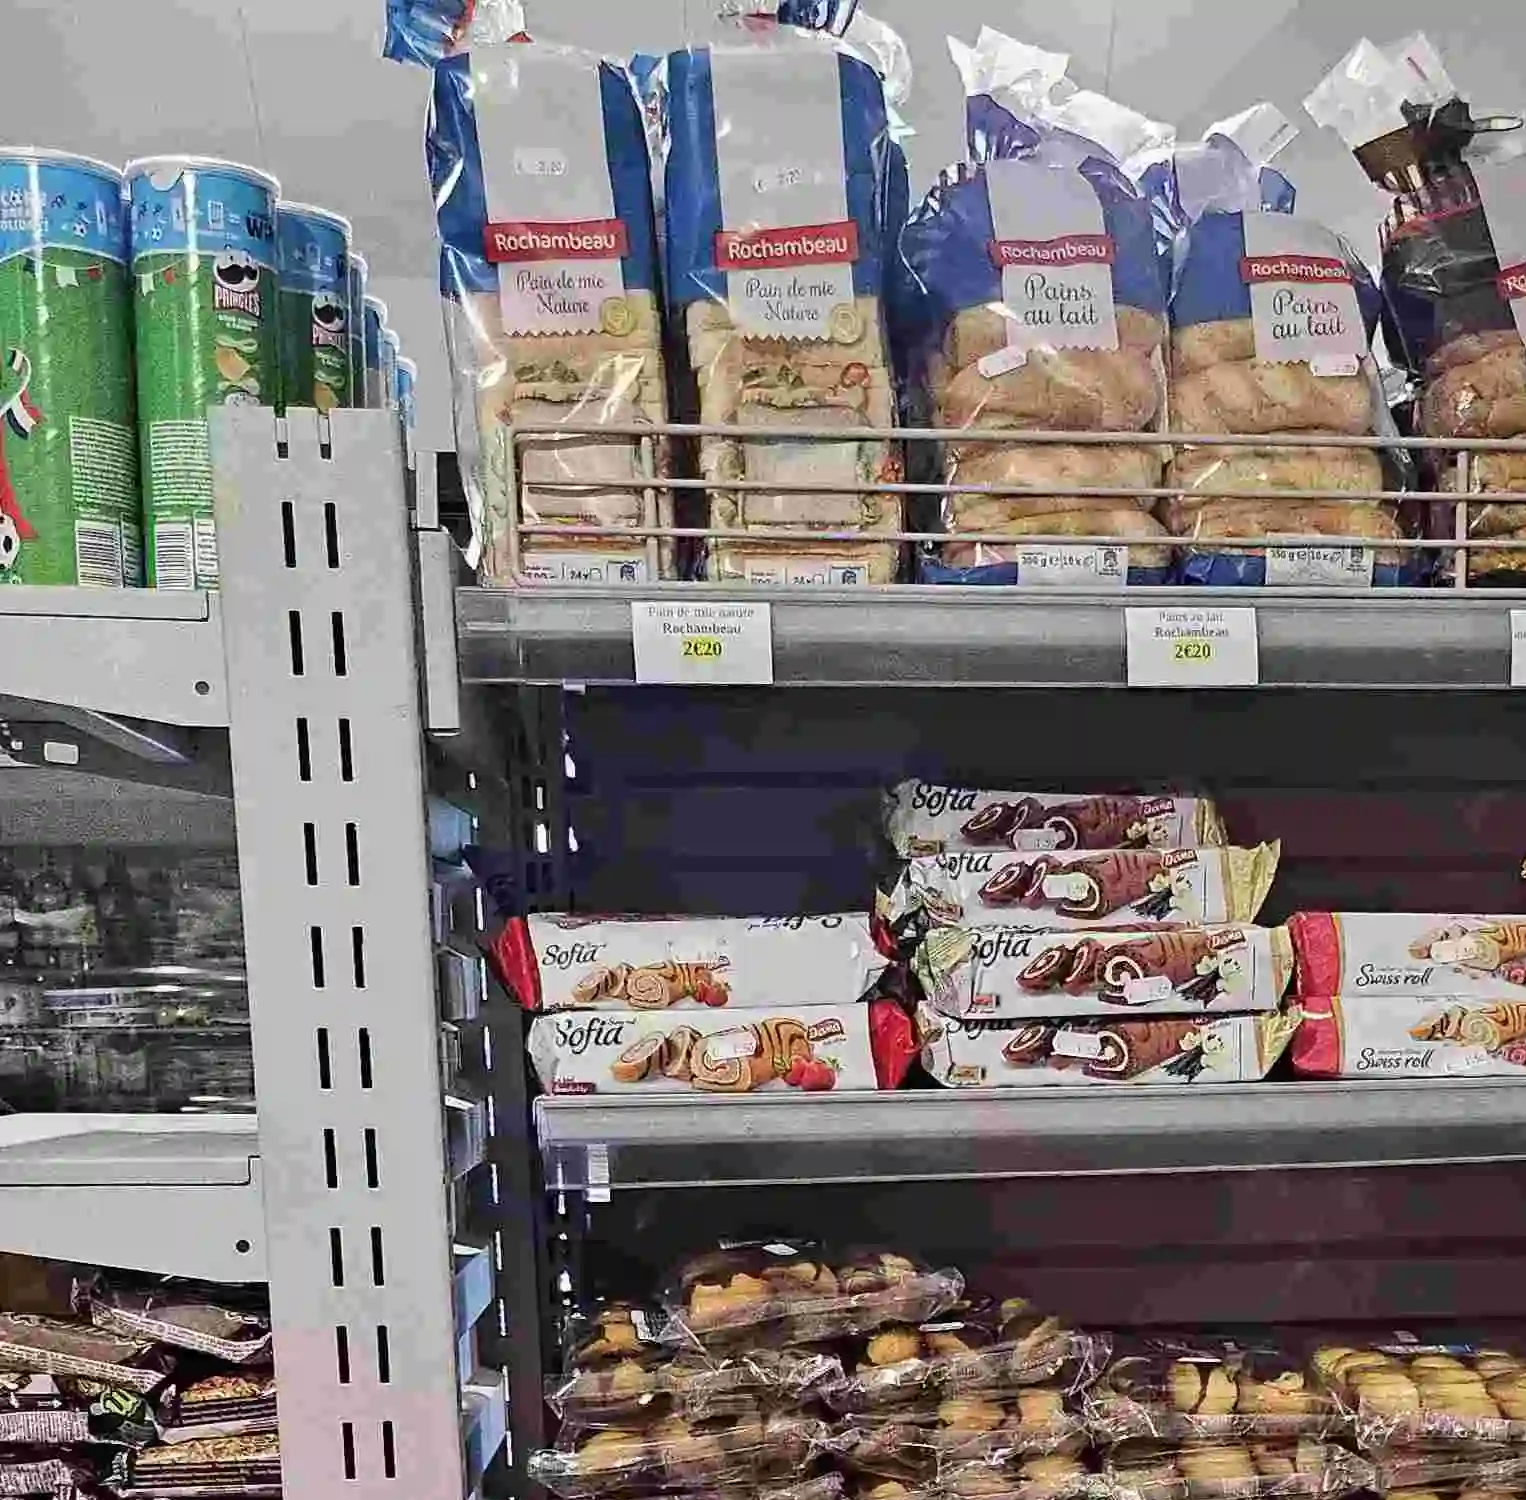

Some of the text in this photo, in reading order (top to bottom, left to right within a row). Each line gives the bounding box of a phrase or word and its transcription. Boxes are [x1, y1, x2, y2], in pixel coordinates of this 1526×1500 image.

[495, 232, 616, 252] Rochambeau
[727, 236, 848, 260] Rochambeau
[1001, 242, 1107, 261] Rochambeau
[1251, 263, 1351, 280] Rochambeau
[746, 277, 834, 300] Pain de mie
[1023, 272, 1094, 300] Pains
[764, 301, 819, 322] Nature
[1023, 302, 1099, 327] au lait
[663, 622, 742, 635] Rochambeau
[1155, 627, 1230, 640] Rochambeau
[683, 642, 723, 657] 2€20
[1175, 644, 1211, 659] 2€20
[911, 784, 977, 816] Sofia
[542, 943, 599, 970] Sofia
[1356, 962, 1432, 990] Swiss roll
[554, 1017, 624, 1055] Sofia
